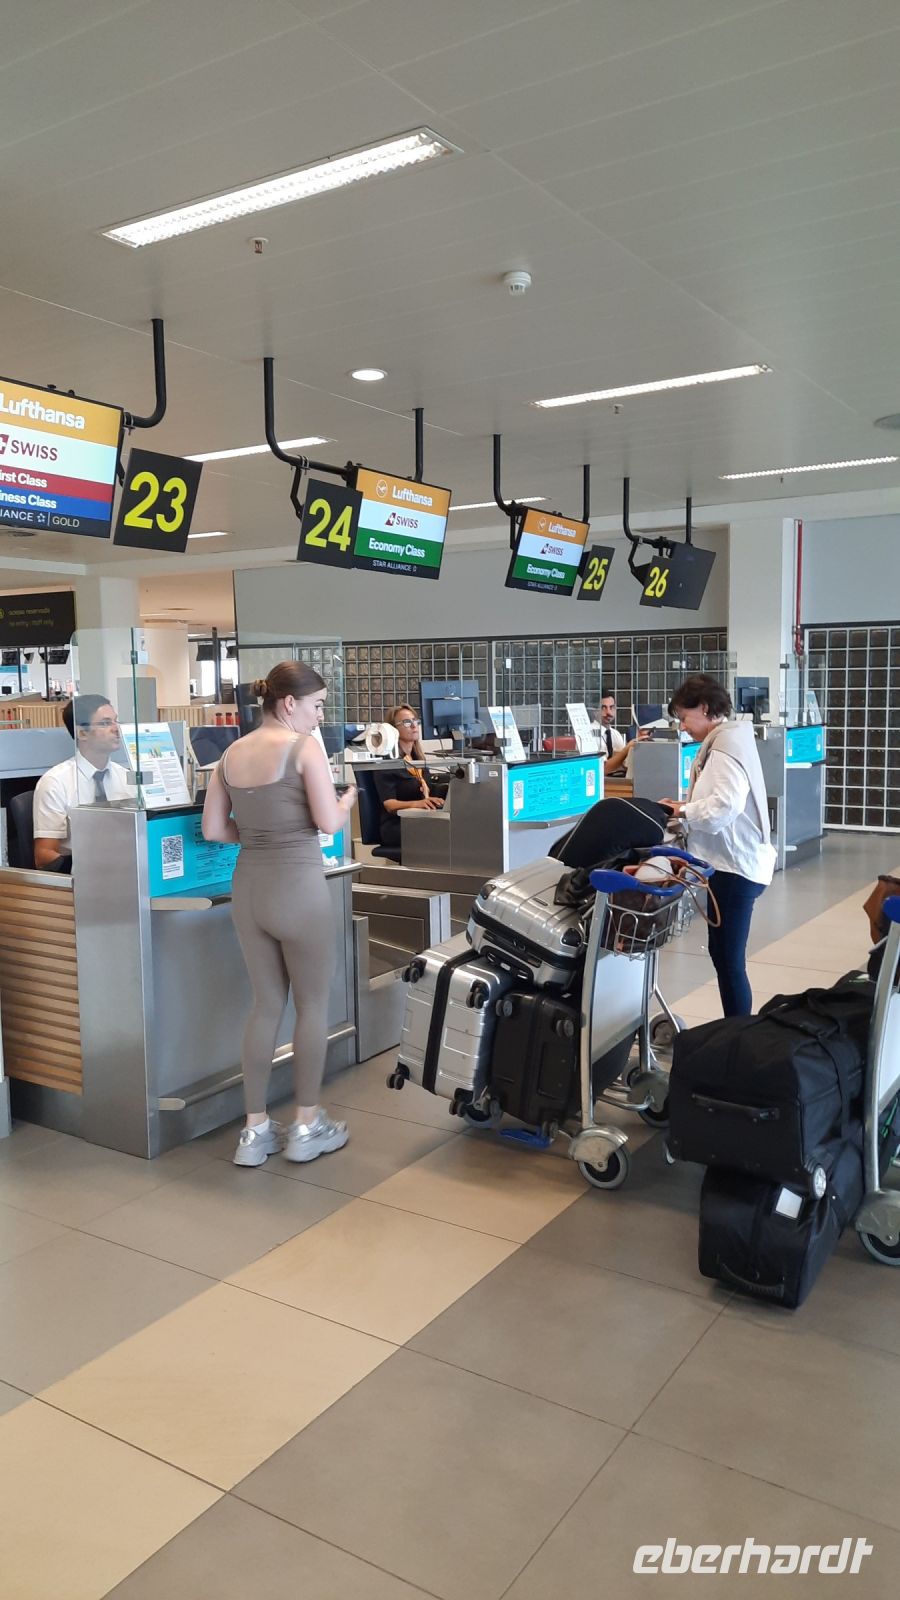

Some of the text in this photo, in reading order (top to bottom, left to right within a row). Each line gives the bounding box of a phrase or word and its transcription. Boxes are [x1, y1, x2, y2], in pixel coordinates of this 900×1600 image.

[0, 392, 85, 430] Lufthansa
[10, 439, 58, 462] SWISS
[0, 469, 48, 488] irst Class
[28, 494, 57, 509] Class
[123, 471, 188, 533] 23
[392, 485, 433, 507] Lufthansa
[52, 515, 80, 528] GOLD
[305, 498, 353, 552] 24
[395, 515, 419, 529] SWISS
[369, 537, 426, 558] Economy Class
[548, 545, 564, 556] SWISS
[372, 559, 412, 572] STAR ALLIANCE
[582, 557, 608, 591] 25
[644, 566, 670, 598] 26
